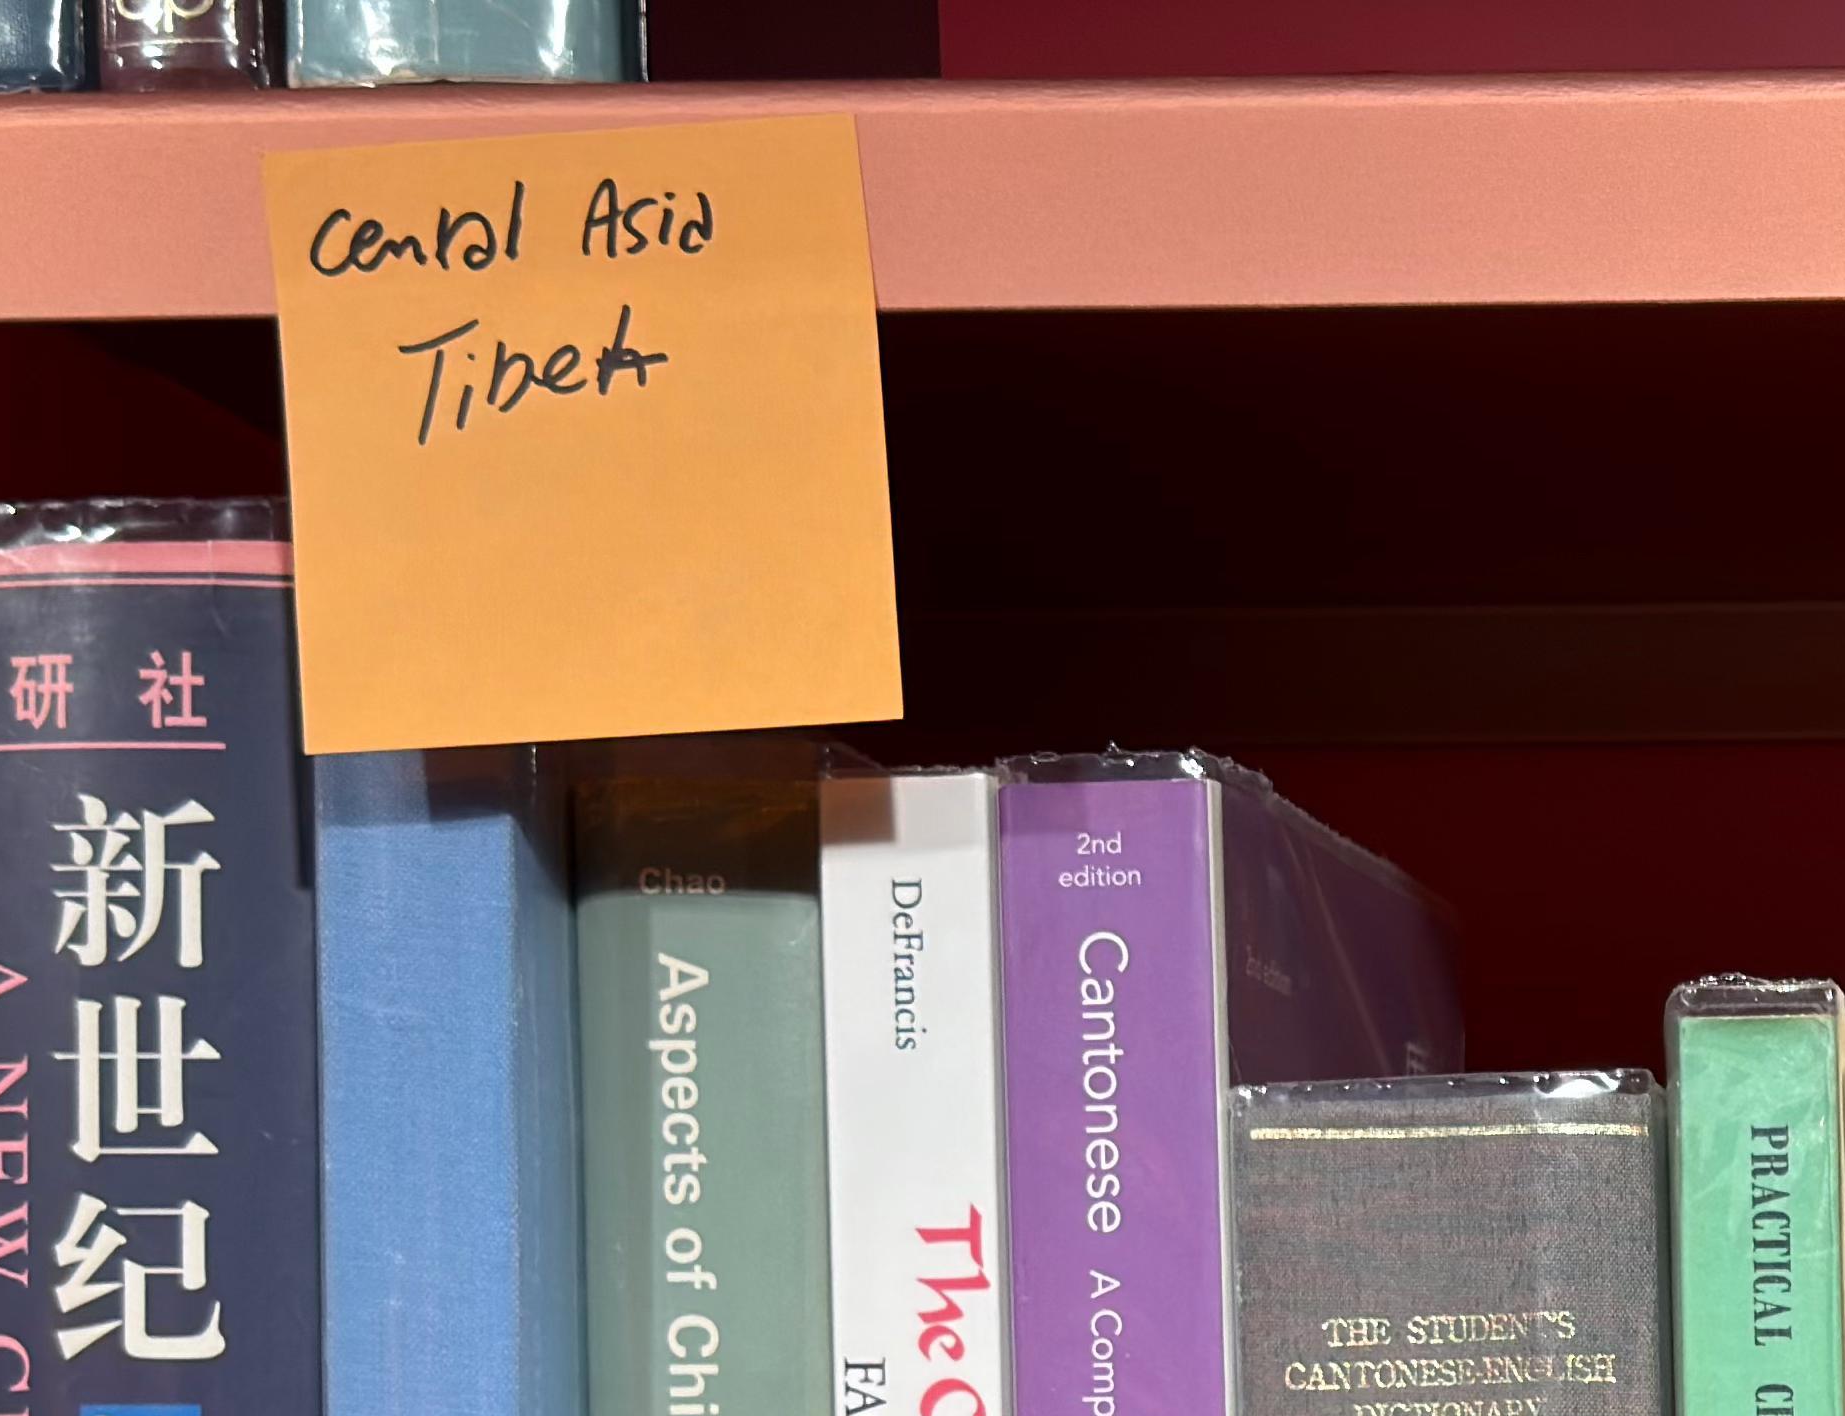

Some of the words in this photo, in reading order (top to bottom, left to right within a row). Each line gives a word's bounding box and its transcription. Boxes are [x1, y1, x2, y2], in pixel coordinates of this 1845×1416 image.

[581, 177, 714, 259] Asia
[1058, 865, 1143, 888] edition
[1076, 832, 1124, 856] 2nd
[638, 866, 727, 896] Chao
[891, 876, 928, 1052] DeFrancis
[49, 791, 226, 1362] 新世纪
[648, 951, 710, 1206] Aspects
[1077, 931, 1130, 1235] Cantonese
[664, 1226, 718, 1291] of
[1750, 1124, 1794, 1348] PRACTICAL
[913, 1202, 991, 1362] The
[1088, 1269, 1122, 1300] A
[1321, 1318, 1391, 1348] THE
[1284, 1354, 1617, 1391] CANTONESE-ENGLISH
